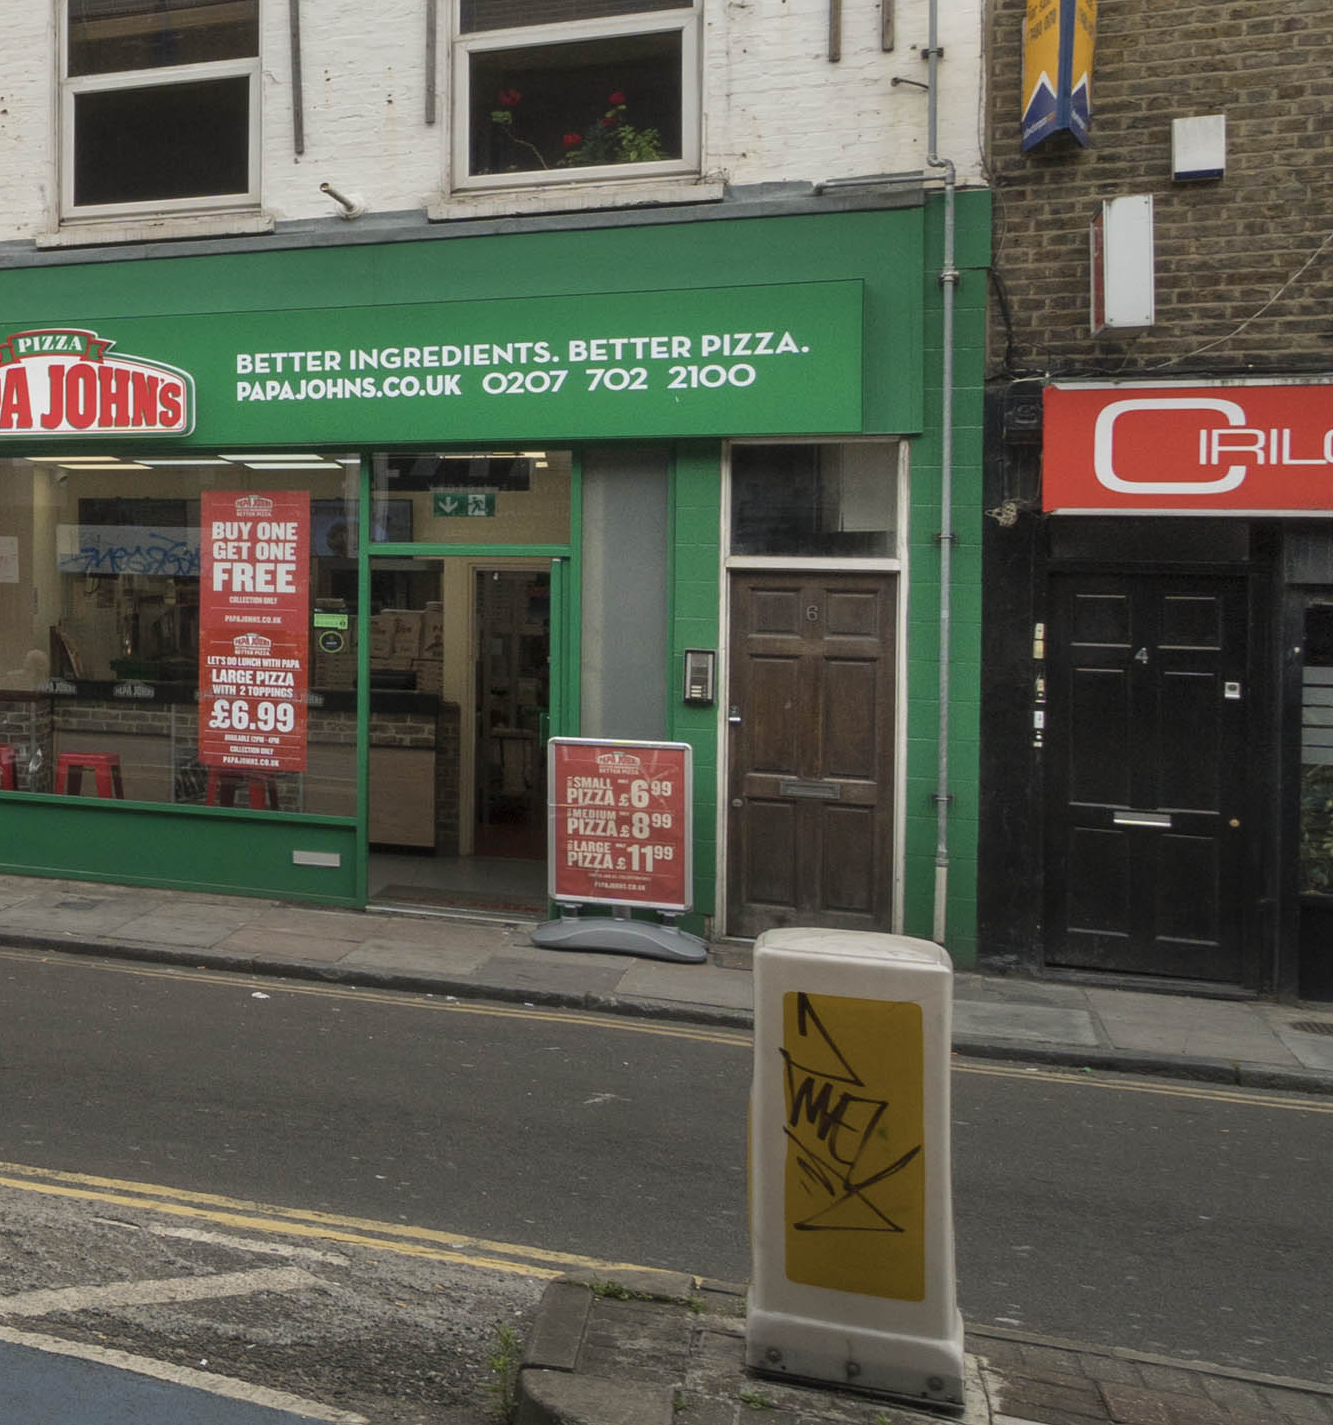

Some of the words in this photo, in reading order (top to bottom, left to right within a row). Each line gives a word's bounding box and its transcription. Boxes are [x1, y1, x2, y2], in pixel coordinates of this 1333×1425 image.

[18, 334, 83, 354] PIZZA
[236, 350, 342, 374] BETTER
[348, 340, 560, 371] INGREDIENTS.
[568, 336, 692, 363] BETTER
[701, 331, 810, 358] PIZZA.
[236, 373, 462, 402] PAPAJOHNS.CO.UK
[481, 369, 569, 395] 0207
[585, 366, 649, 392] 702
[666, 363, 757, 389] 2100
[40, 363, 182, 430] JOHN'S
[212, 521, 253, 540] BUY
[256, 521, 298, 541] ONE
[213, 541, 252, 560] GET
[255, 541, 297, 561] ONE
[213, 562, 297, 593] FREE
[806, 605, 819, 622] 6
[207, 655, 228, 666] LET'S
[227, 656, 238, 667] DO
[237, 656, 262, 667] LUNCH
[261, 658, 281, 668] WITH
[281, 659, 301, 669] PAPA
[1134, 646, 1149, 664] 4
[212, 668, 254, 685] LARGE
[255, 670, 295, 687] PIZZA
[213, 684, 237, 696] WITH
[239, 685, 246, 696] 2
[247, 685, 294, 699] TOPPINGS
[208, 698, 295, 733] £6.99
[573, 776, 613, 790] SMALL
[566, 788, 615, 806] PIZZA
[573, 808, 617, 820] MEDIUM
[566, 817, 619, 837] PIZZA
[573, 840, 612, 853] LARGE
[566, 851, 614, 870] PIZZA
